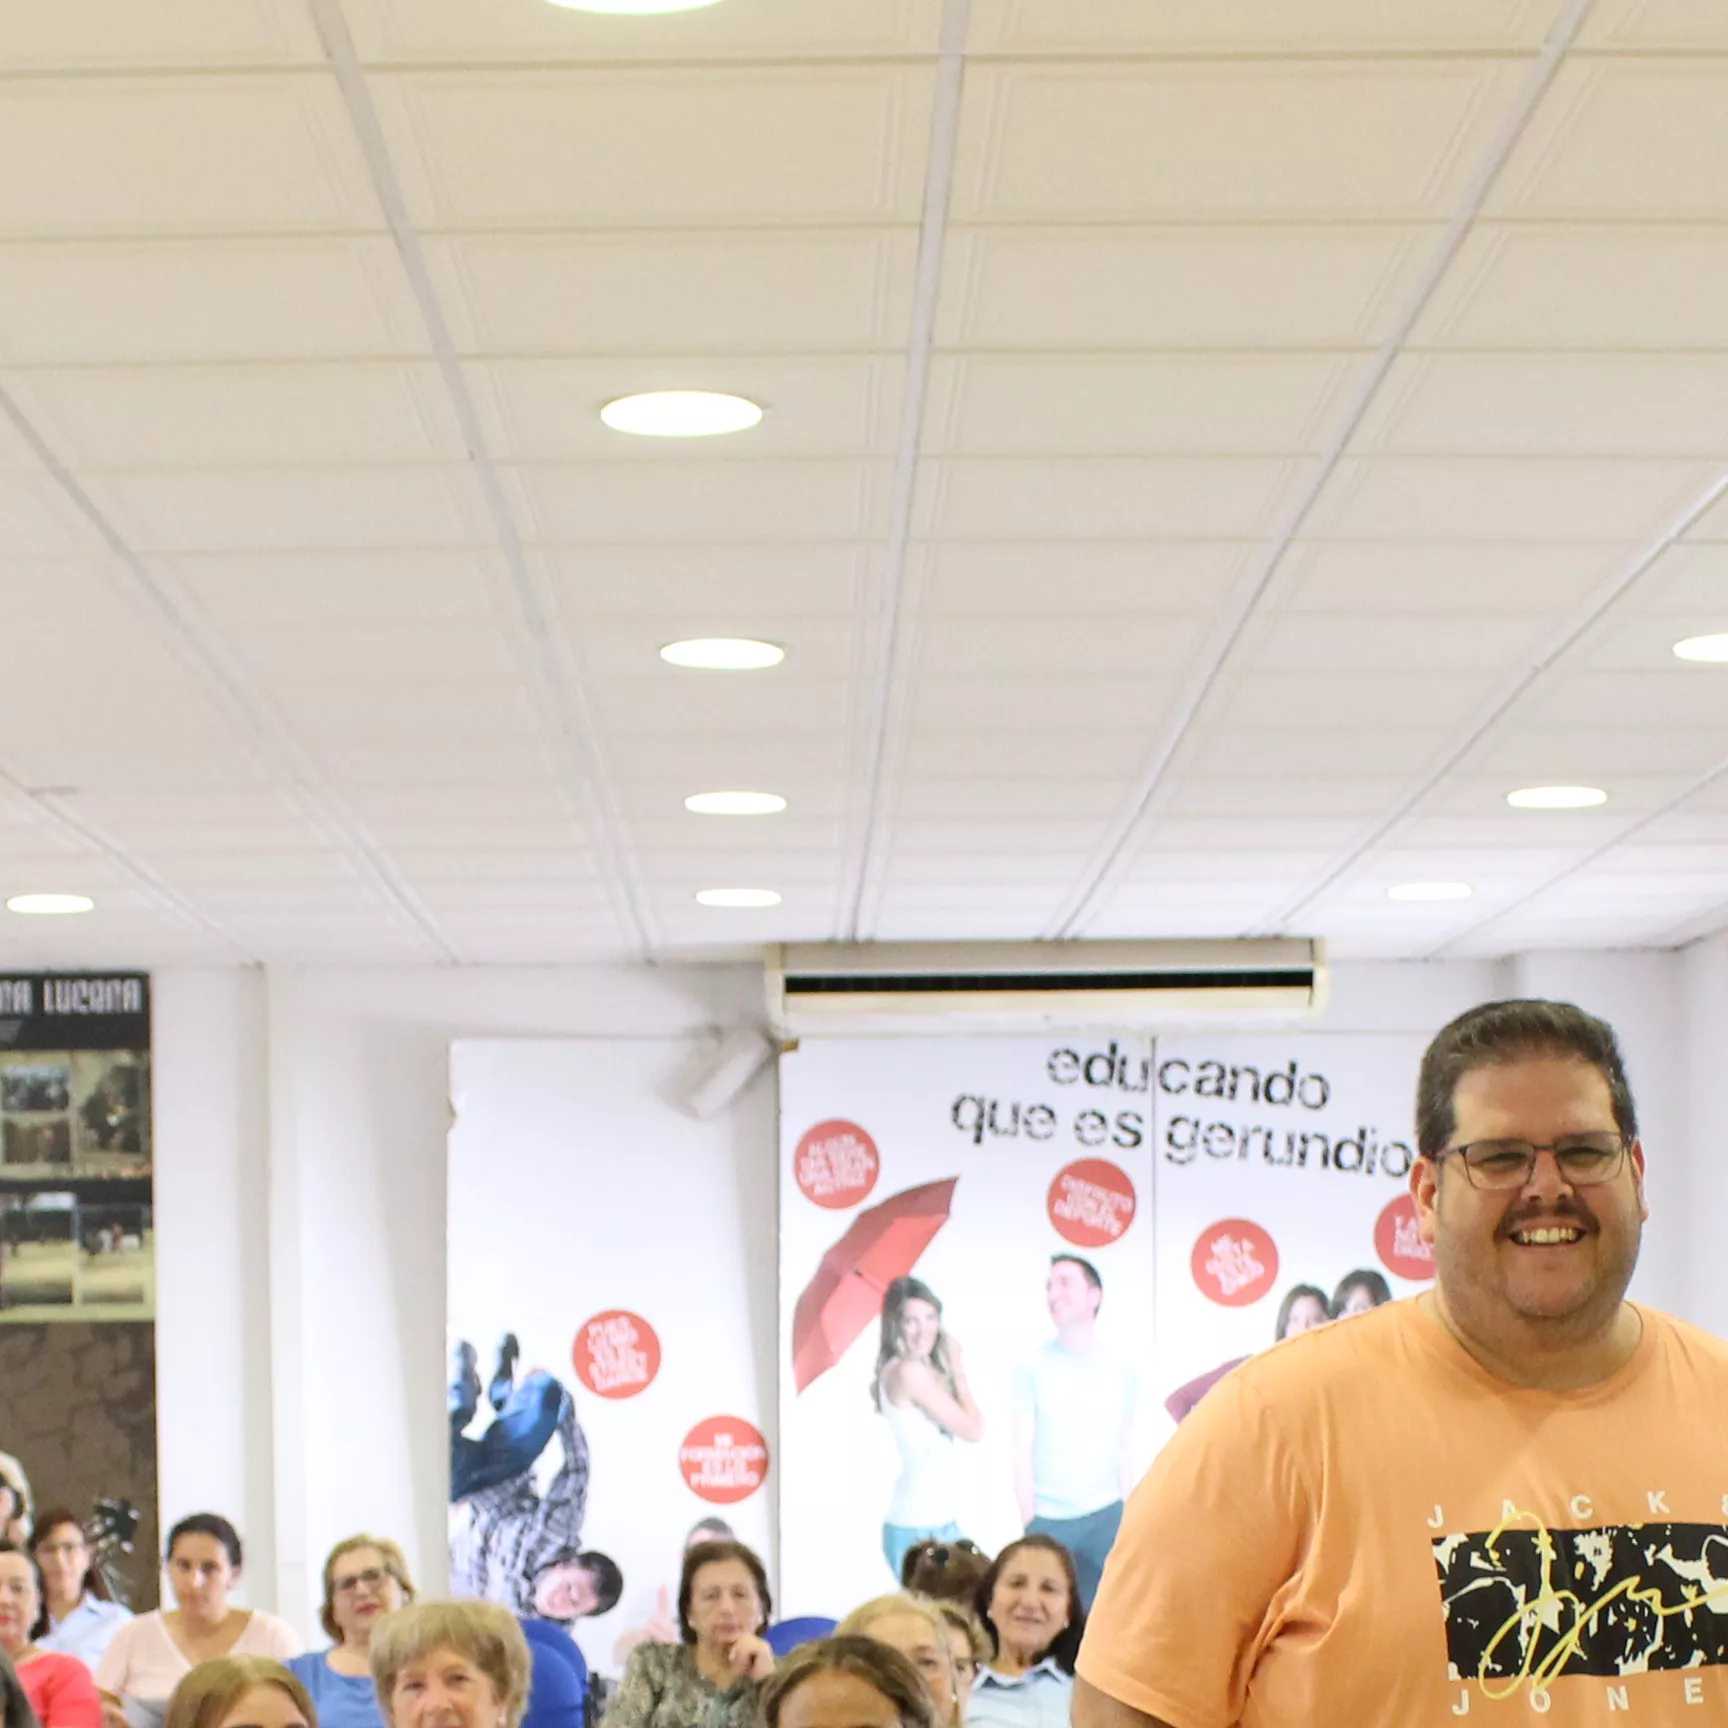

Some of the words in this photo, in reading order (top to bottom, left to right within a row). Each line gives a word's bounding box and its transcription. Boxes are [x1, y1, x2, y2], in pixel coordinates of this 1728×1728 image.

[1047, 1040, 1330, 1111] educando
[951, 1091, 1057, 1144] que
[1074, 1107, 1144, 1150] es
[1165, 1112, 1412, 1180] gerundio
[1428, 1490, 1670, 1528] JACK
